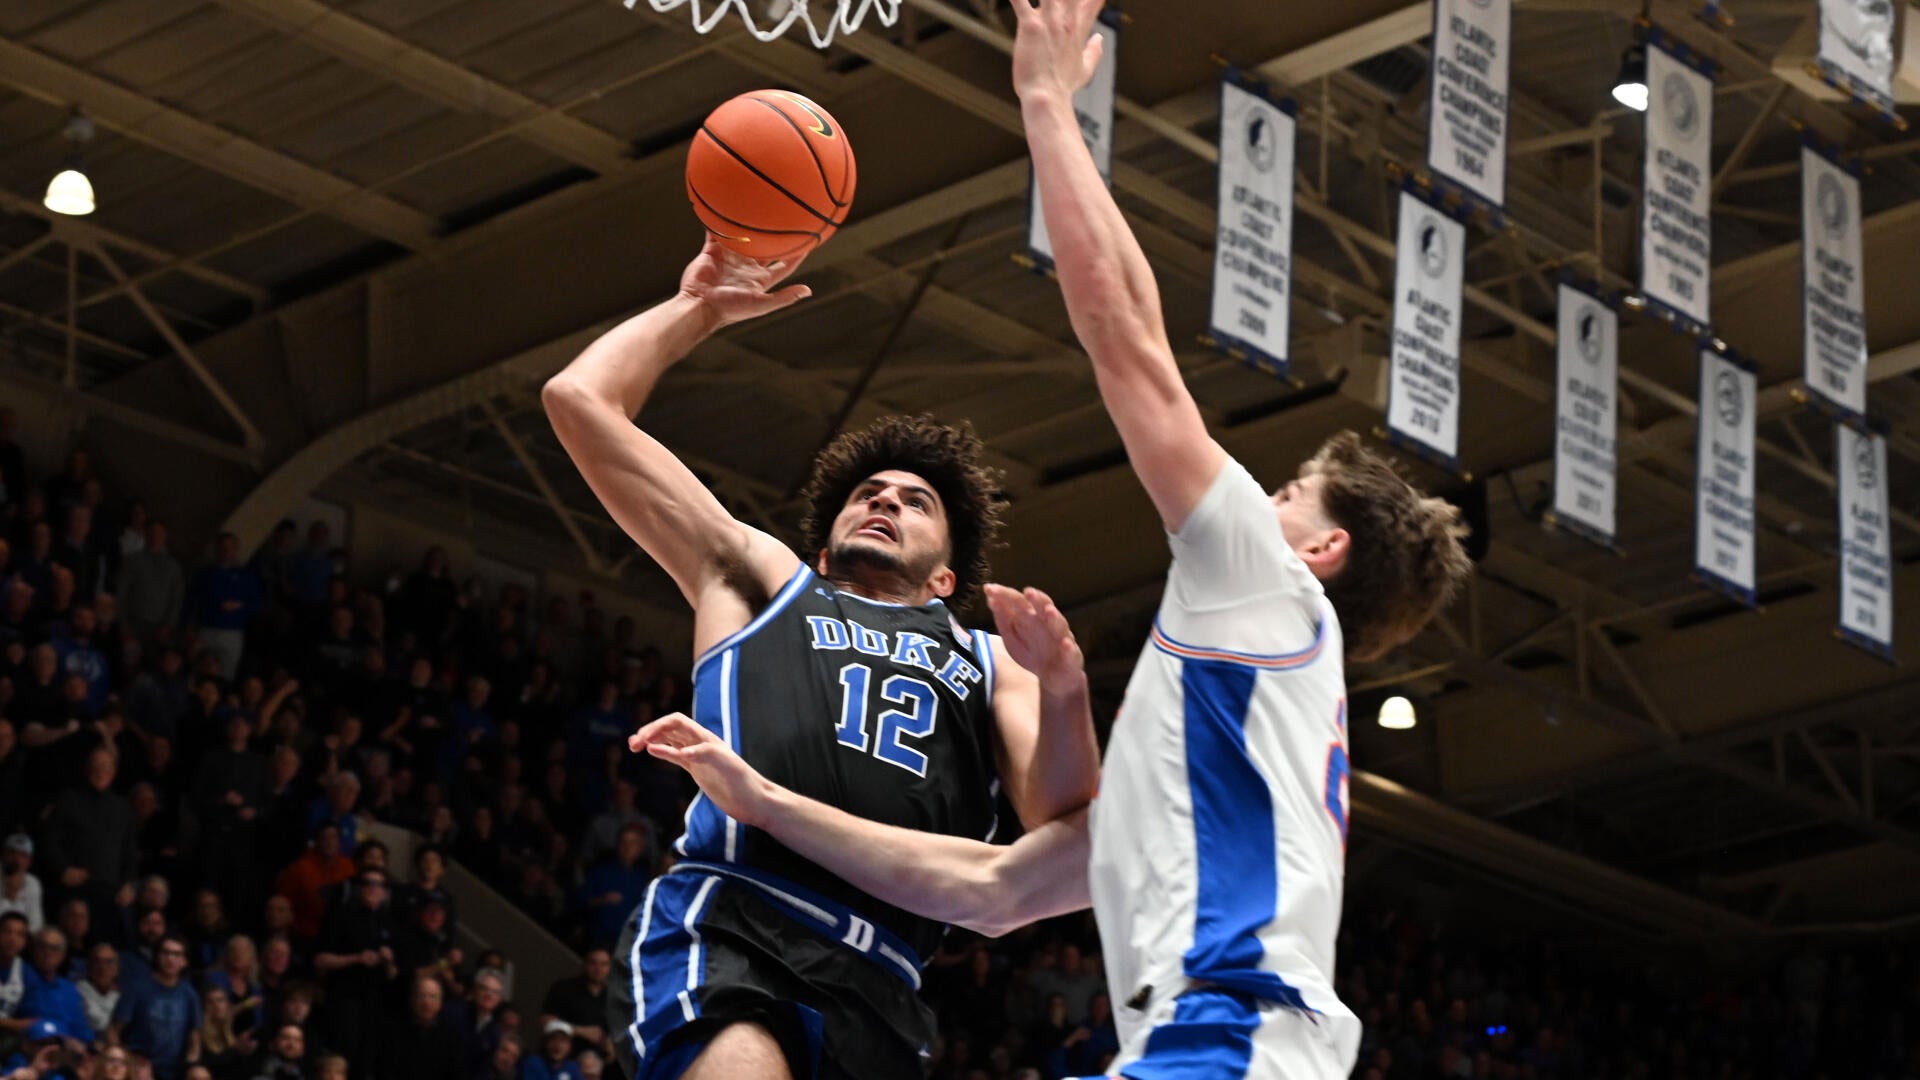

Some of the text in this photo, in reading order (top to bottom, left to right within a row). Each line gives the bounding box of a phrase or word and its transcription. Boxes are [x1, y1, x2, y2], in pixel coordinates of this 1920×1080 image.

[1450, 16, 1496, 58] ATLANTIC
[1455, 43, 1490, 75] COAST
[1438, 56, 1506, 113] CONFERENCE
[1440, 83, 1501, 135] CHAMPIONS
[1232, 185, 1281, 222] ATLANTIC
[1407, 289, 1451, 325] ATLANTIC
[806, 615, 983, 700] DUKE
[835, 662, 939, 779] 12
[842, 913, 875, 953] D
